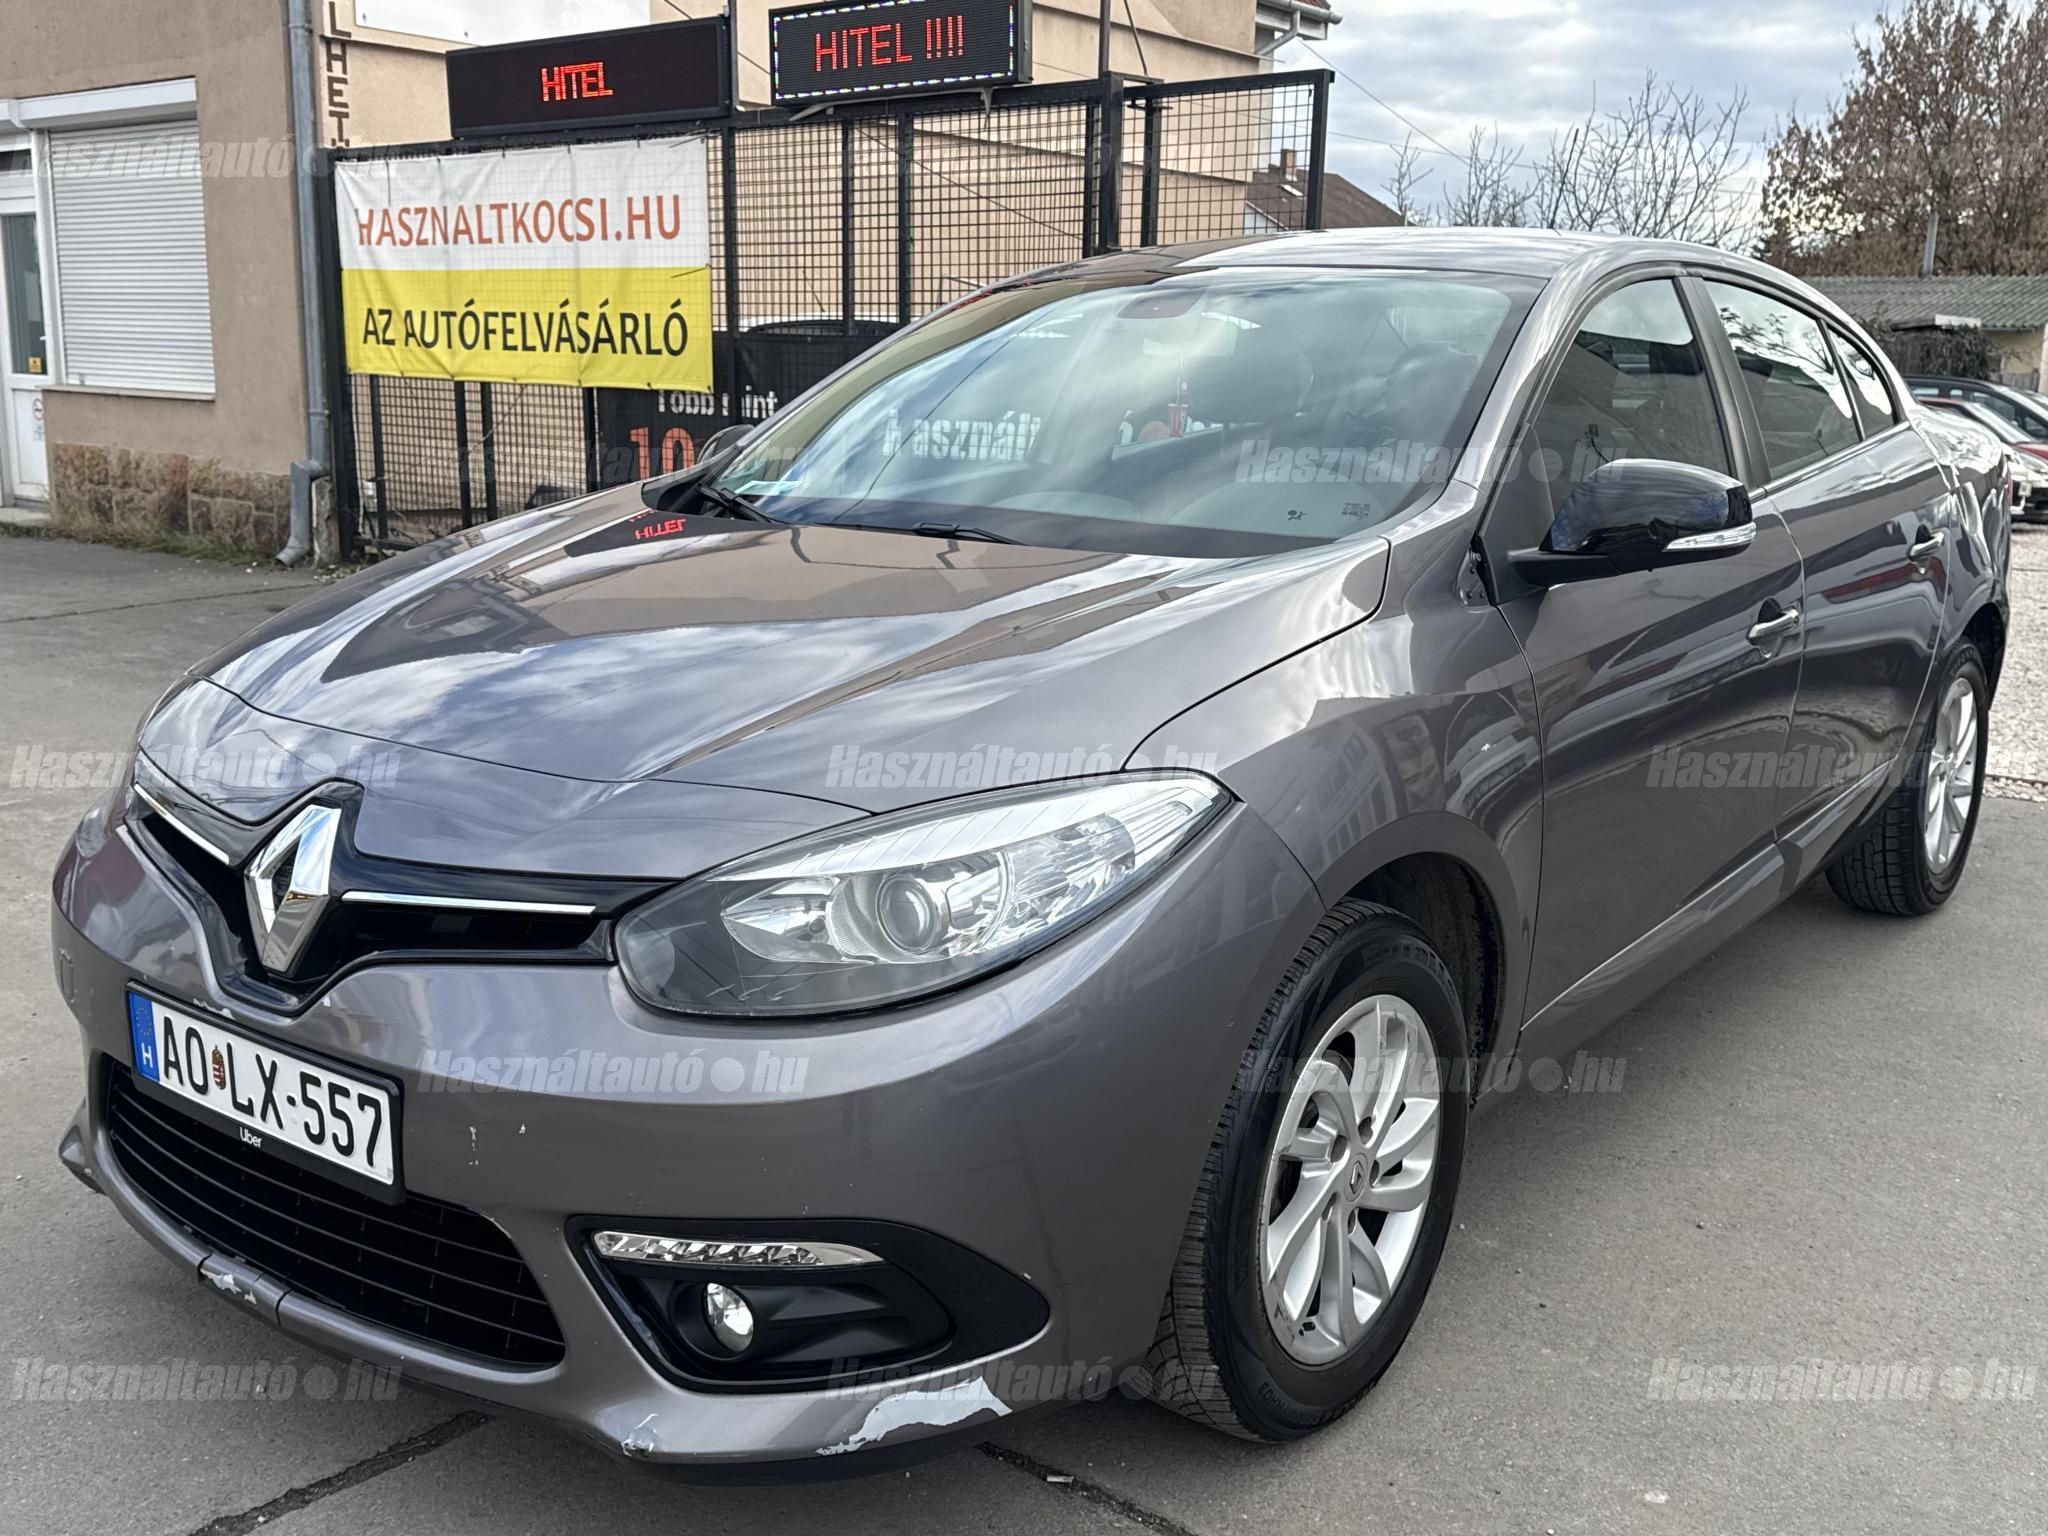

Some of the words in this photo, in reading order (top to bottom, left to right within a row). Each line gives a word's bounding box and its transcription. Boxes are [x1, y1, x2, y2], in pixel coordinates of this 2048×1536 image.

[815, 23, 912, 71] HITEL
[325, 1, 351, 147] LHET
[540, 62, 614, 101] HITEL
[354, 193, 682, 247] HASZNALTKOCSI.HU
[362, 307, 396, 346] AZ
[404, 298, 689, 356] AUTÓFELVÁSÁRLÓ
[239, 1126, 263, 1149] Uber
